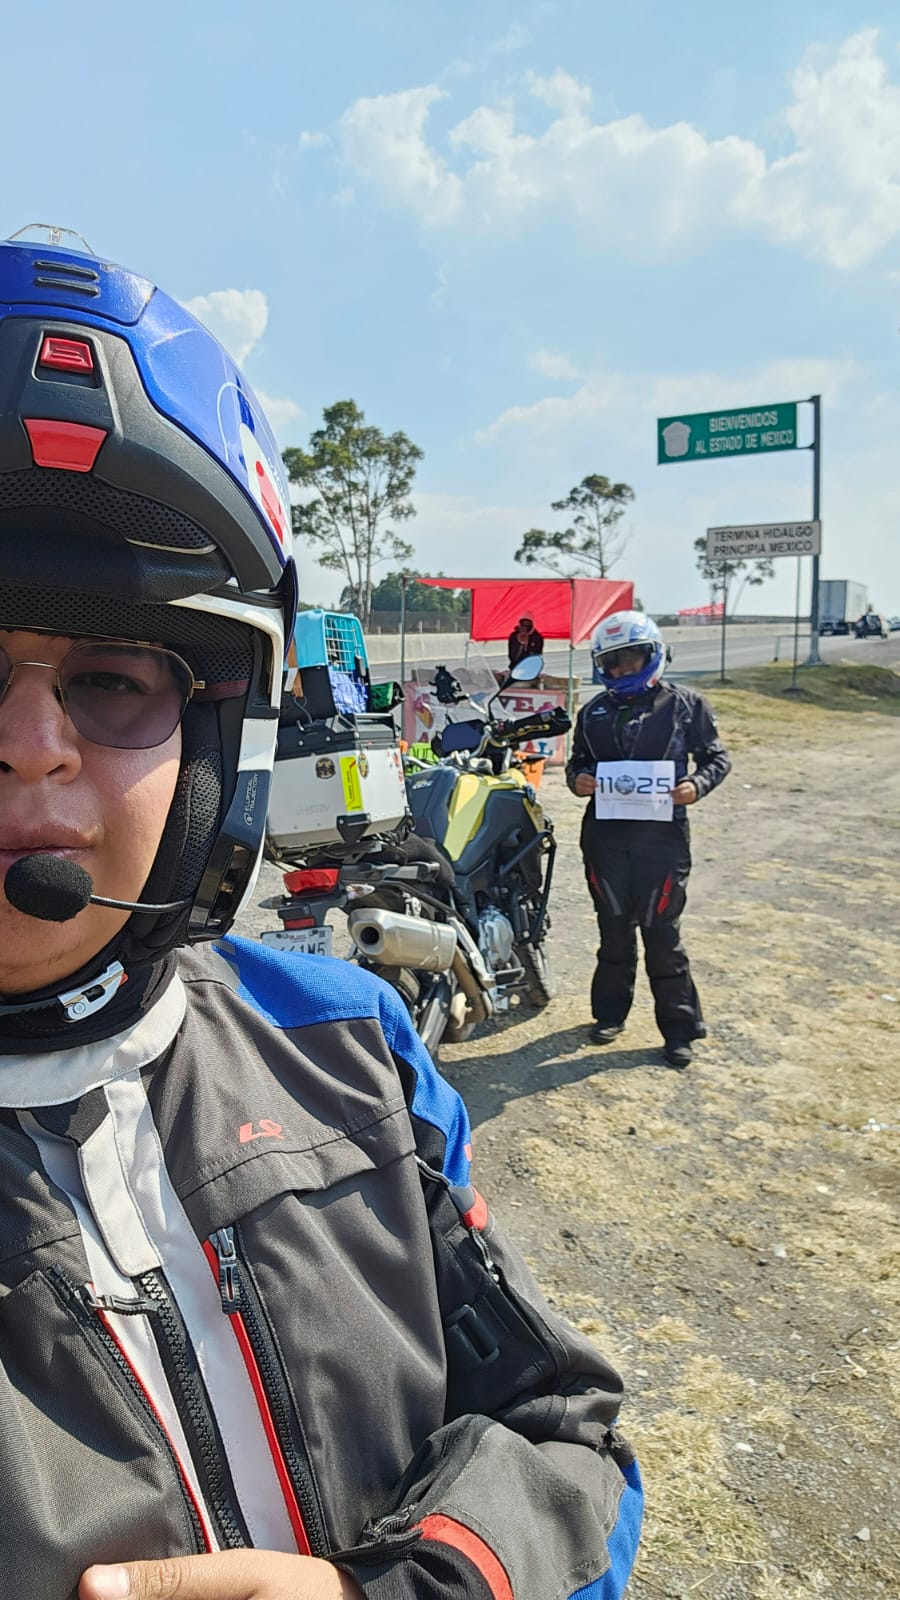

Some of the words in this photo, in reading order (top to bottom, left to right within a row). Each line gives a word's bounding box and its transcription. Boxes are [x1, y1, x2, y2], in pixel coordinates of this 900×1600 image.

[709, 411, 778, 432] BIENVENIDOS
[695, 440, 707, 454] AL
[709, 435, 743, 453] ESTADO
[745, 433, 758, 448] DE
[760, 430, 794, 447] MEXICO
[713, 528, 760, 542] TERMINA
[763, 526, 813, 539] HIDALGO
[713, 543, 767, 556] PRINCIPIA
[769, 540, 813, 553] MEXICO
